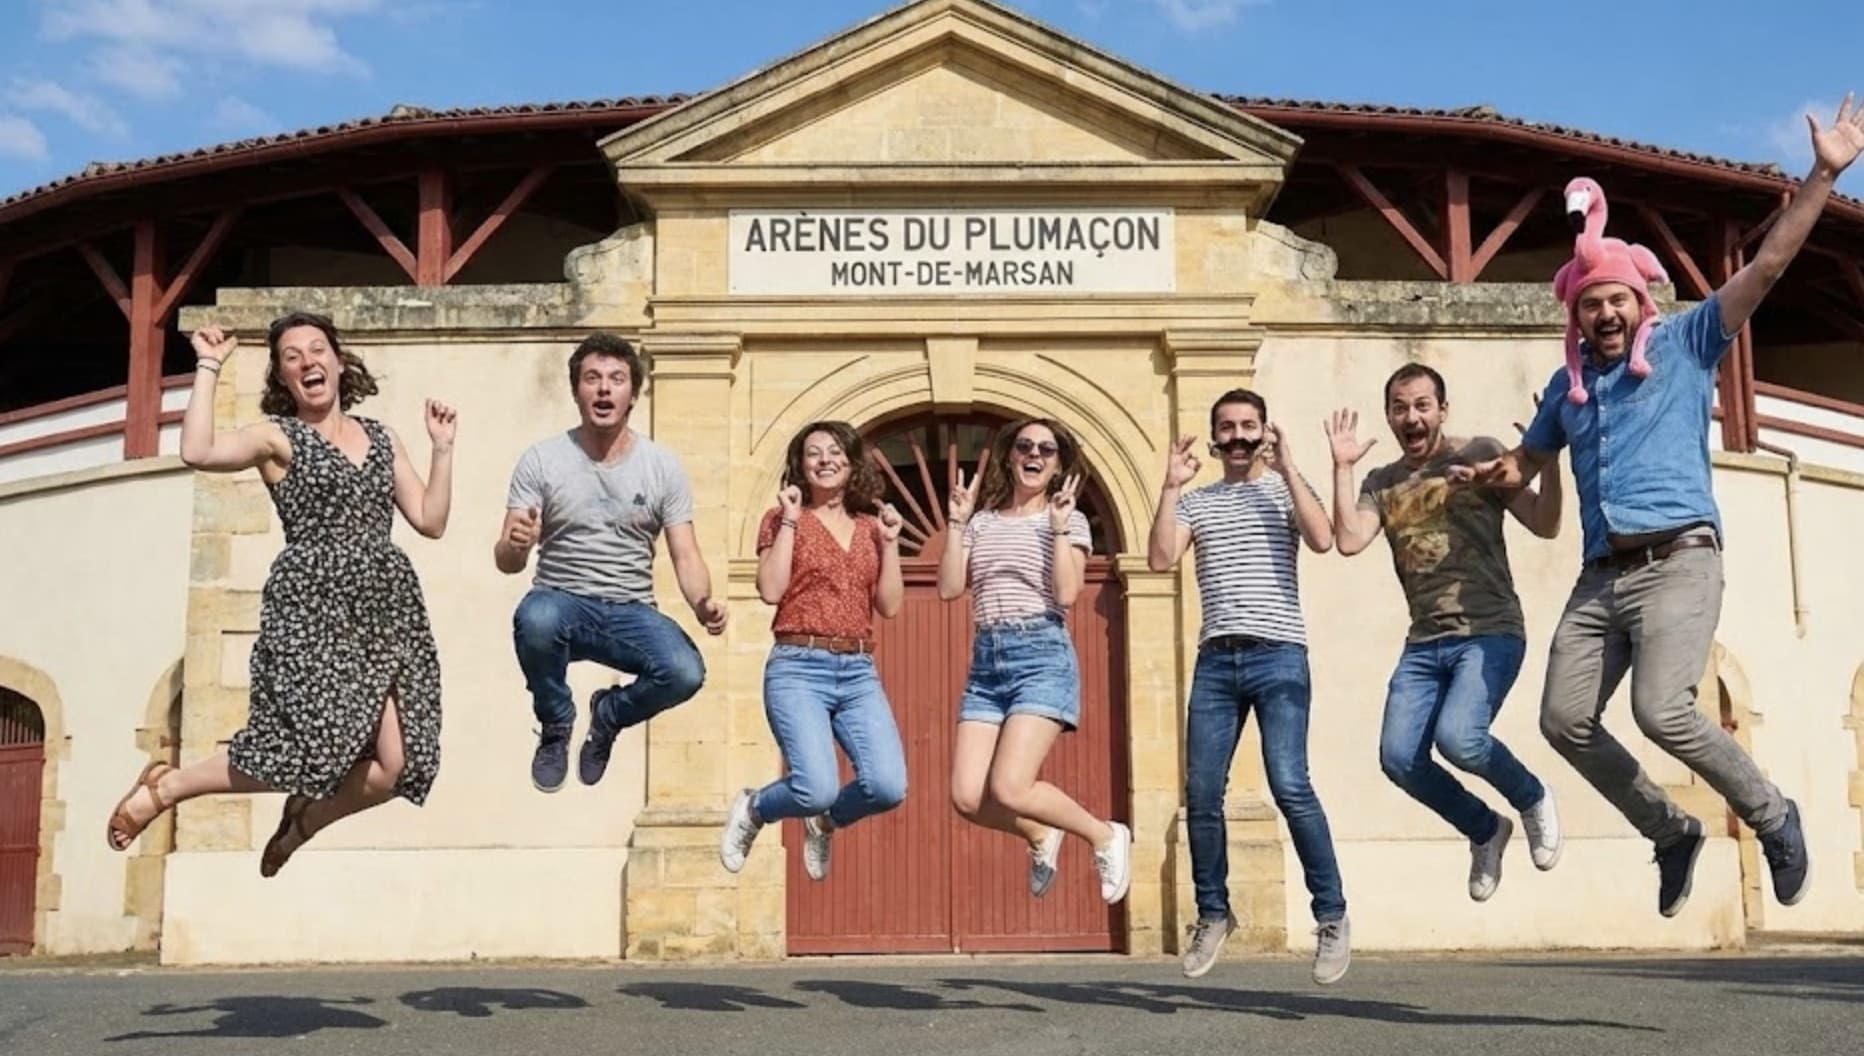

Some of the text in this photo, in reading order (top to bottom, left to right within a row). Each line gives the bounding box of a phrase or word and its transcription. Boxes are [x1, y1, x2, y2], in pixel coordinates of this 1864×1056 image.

[745, 211, 1160, 258] ARÈNES DU PLUMAÇON
[831, 261, 1074, 286] MONT-DE-MARSAN
